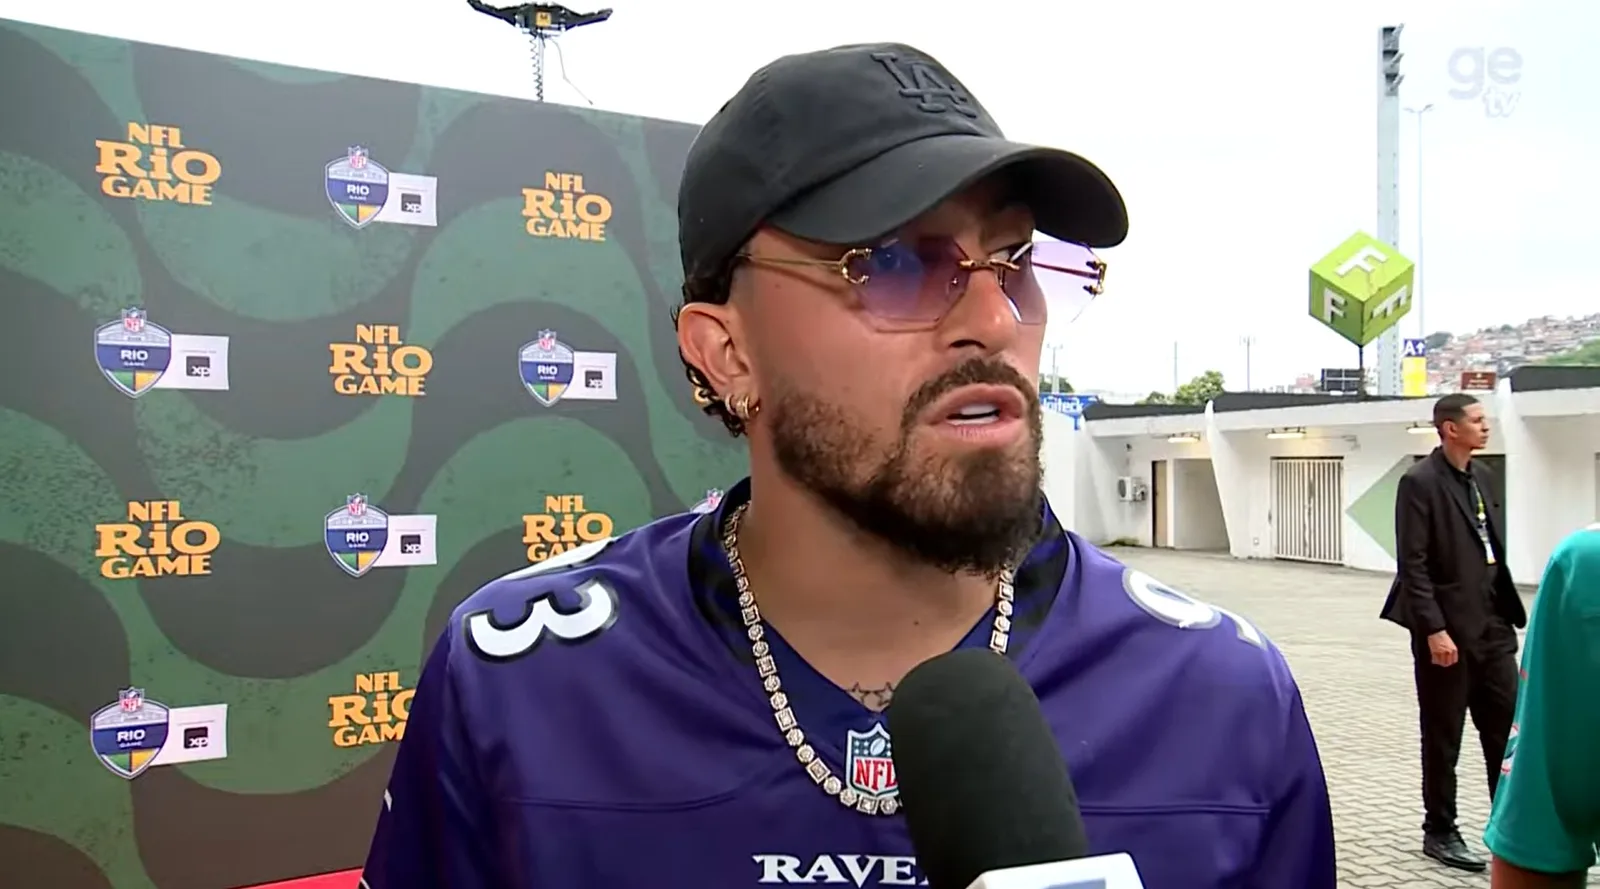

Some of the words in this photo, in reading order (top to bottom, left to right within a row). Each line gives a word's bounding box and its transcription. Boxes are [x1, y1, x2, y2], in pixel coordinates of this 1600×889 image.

[870, 52, 977, 119] LA
[128, 122, 185, 148] NFL
[102, 175, 213, 206] GAME
[347, 184, 370, 195] RIO
[545, 172, 586, 193] NFL
[526, 218, 606, 241] GAME
[1323, 287, 1348, 324] F
[356, 324, 403, 345] NFL
[120, 350, 149, 361] RIO
[1405, 340, 1416, 355] A
[537, 365, 558, 375] RIO
[334, 374, 427, 396] GAME
[128, 500, 184, 522] NFL
[546, 495, 587, 513] NFL
[346, 532, 369, 543] RIO
[527, 543, 577, 562] GA
[100, 554, 212, 579] GAME
[465, 545, 618, 661] 3
[356, 671, 403, 693] NFL
[116, 729, 146, 742] RIO
[334, 721, 406, 746] GAM
[855, 758, 898, 791] NFL
[752, 854, 930, 889] RAVE
